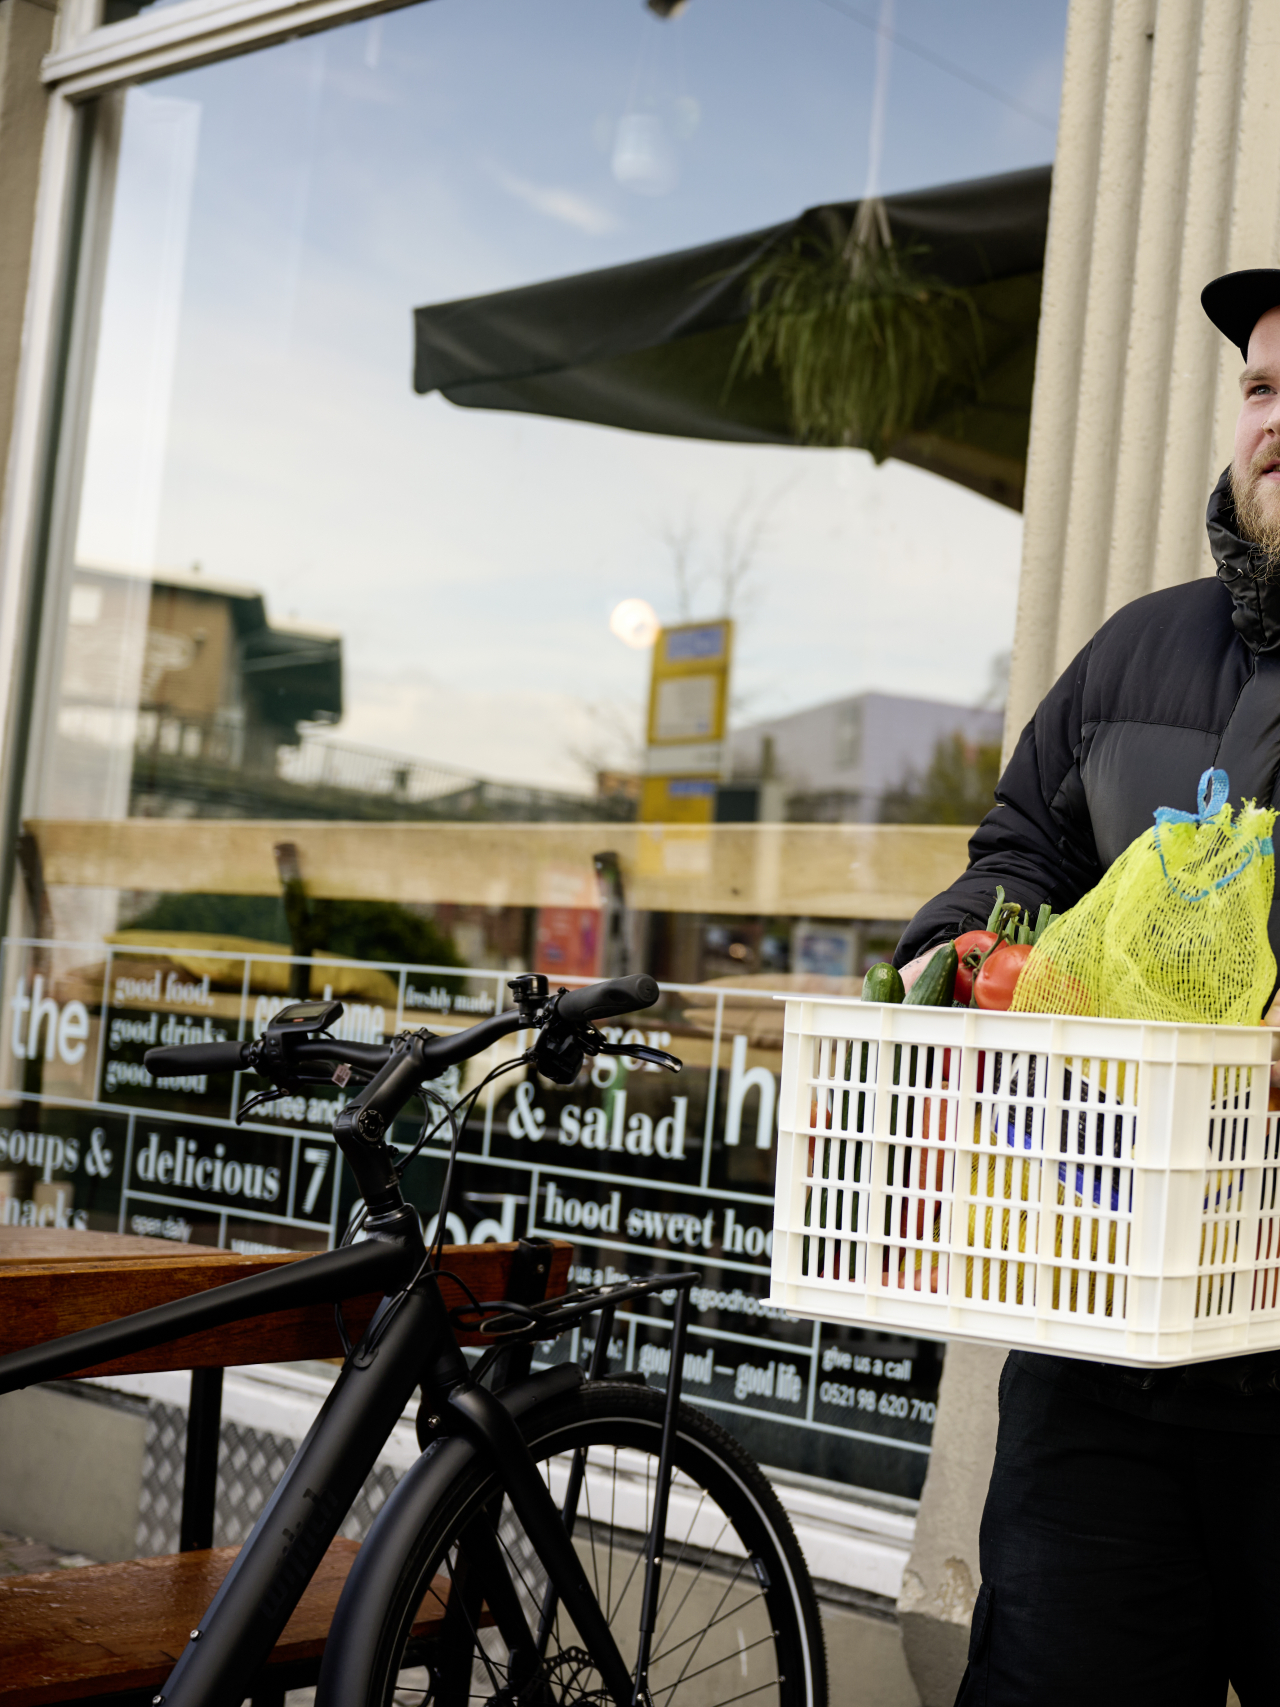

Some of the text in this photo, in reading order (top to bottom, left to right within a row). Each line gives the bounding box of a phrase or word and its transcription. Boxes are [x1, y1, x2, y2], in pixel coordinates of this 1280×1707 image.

[113, 969, 163, 1009] good
[405, 984, 495, 1016] freshly made
[11, 973, 90, 1066] the
[108, 1012, 159, 1051] good
[306, 1092, 346, 1125] and
[507, 1081, 688, 1161] & salad
[0, 1126, 113, 1185] soups &
[136, 1133, 281, 1202] delicious
[302, 1147, 331, 1214] 7
[1, 1189, 89, 1230] nacks
[543, 1181, 622, 1234] hood
[625, 1208, 715, 1250] sweet
[638, 1343, 672, 1380] goo
[734, 1360, 776, 1401] good
[775, 1361, 802, 1403] life
[822, 1345, 912, 1382] give us a call
[819, 1381, 937, 1425] 0521 98 620 710
